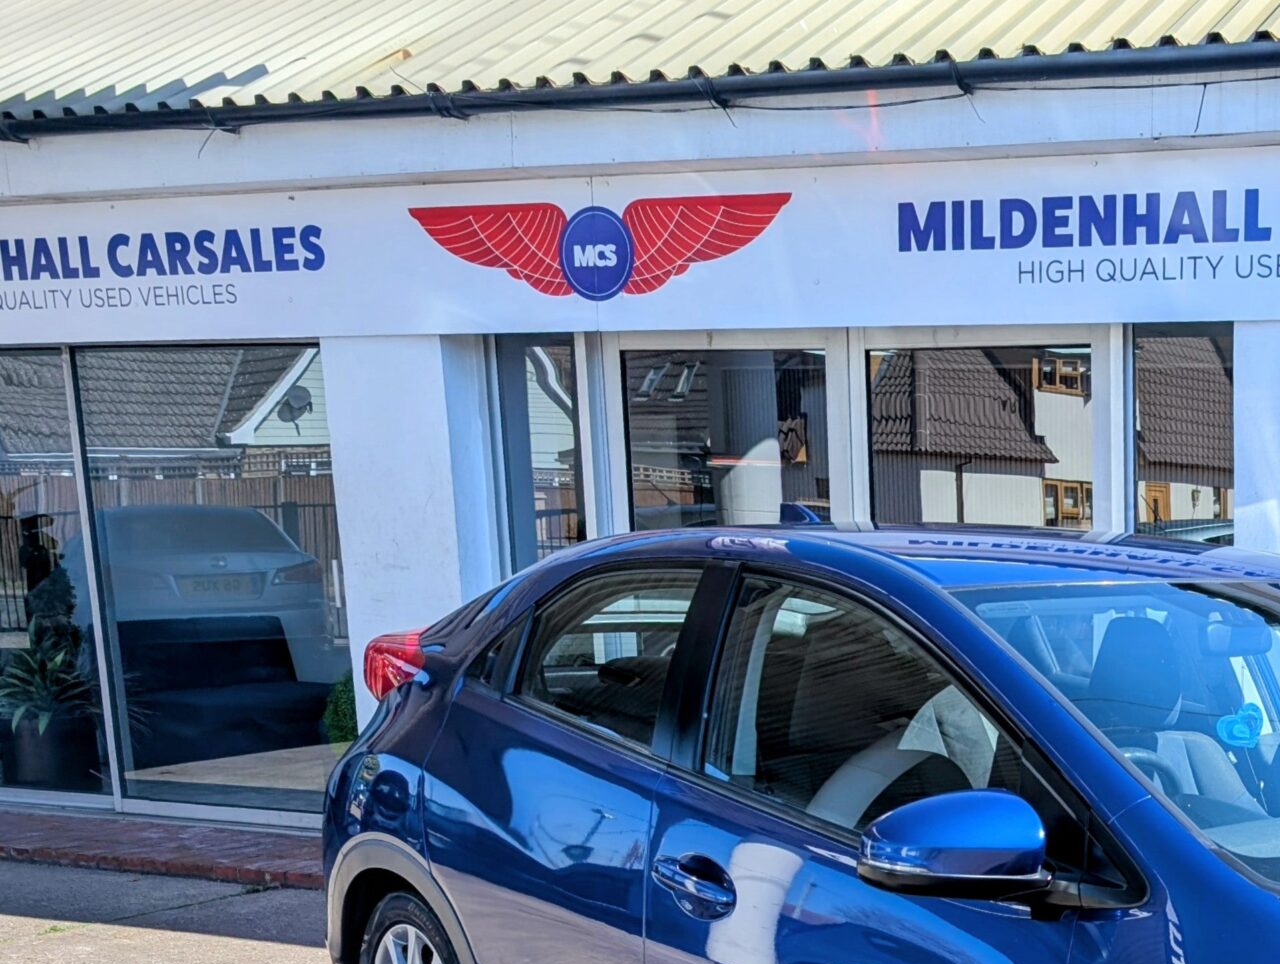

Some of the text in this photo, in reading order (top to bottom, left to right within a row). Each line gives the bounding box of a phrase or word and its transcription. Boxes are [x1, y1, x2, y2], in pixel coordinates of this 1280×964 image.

[898, 188, 1272, 252] MILDENHALL
[107, 224, 325, 278] CARSALES
[573, 244, 618, 267] MCS
[1018, 258, 1084, 284] HIGH
[1096, 255, 1224, 282] QUALITY
[0, 283, 238, 310] UALITY USED VEHICLES
